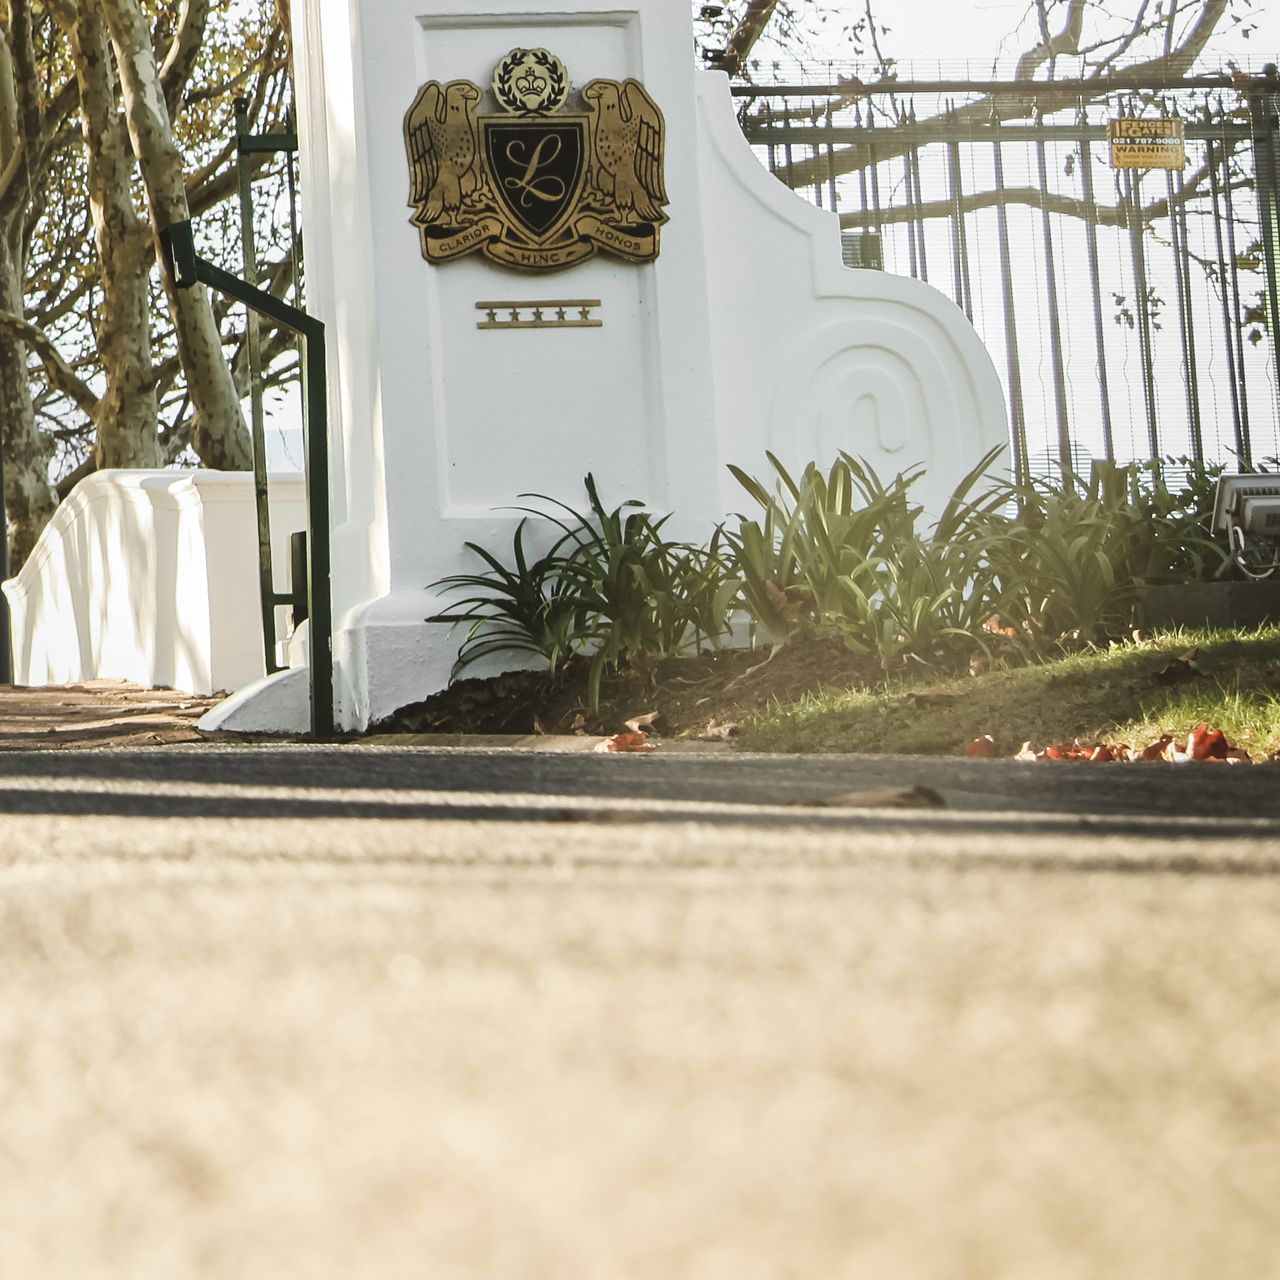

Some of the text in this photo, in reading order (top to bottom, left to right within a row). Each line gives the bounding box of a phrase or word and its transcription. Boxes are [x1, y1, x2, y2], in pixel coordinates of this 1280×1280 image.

[1121, 121, 1171, 129] FENCES
[1128, 128, 1171, 137] GATES
[505, 133, 565, 207] L
[439, 224, 640, 263] CLARIOR HINC HONOS
